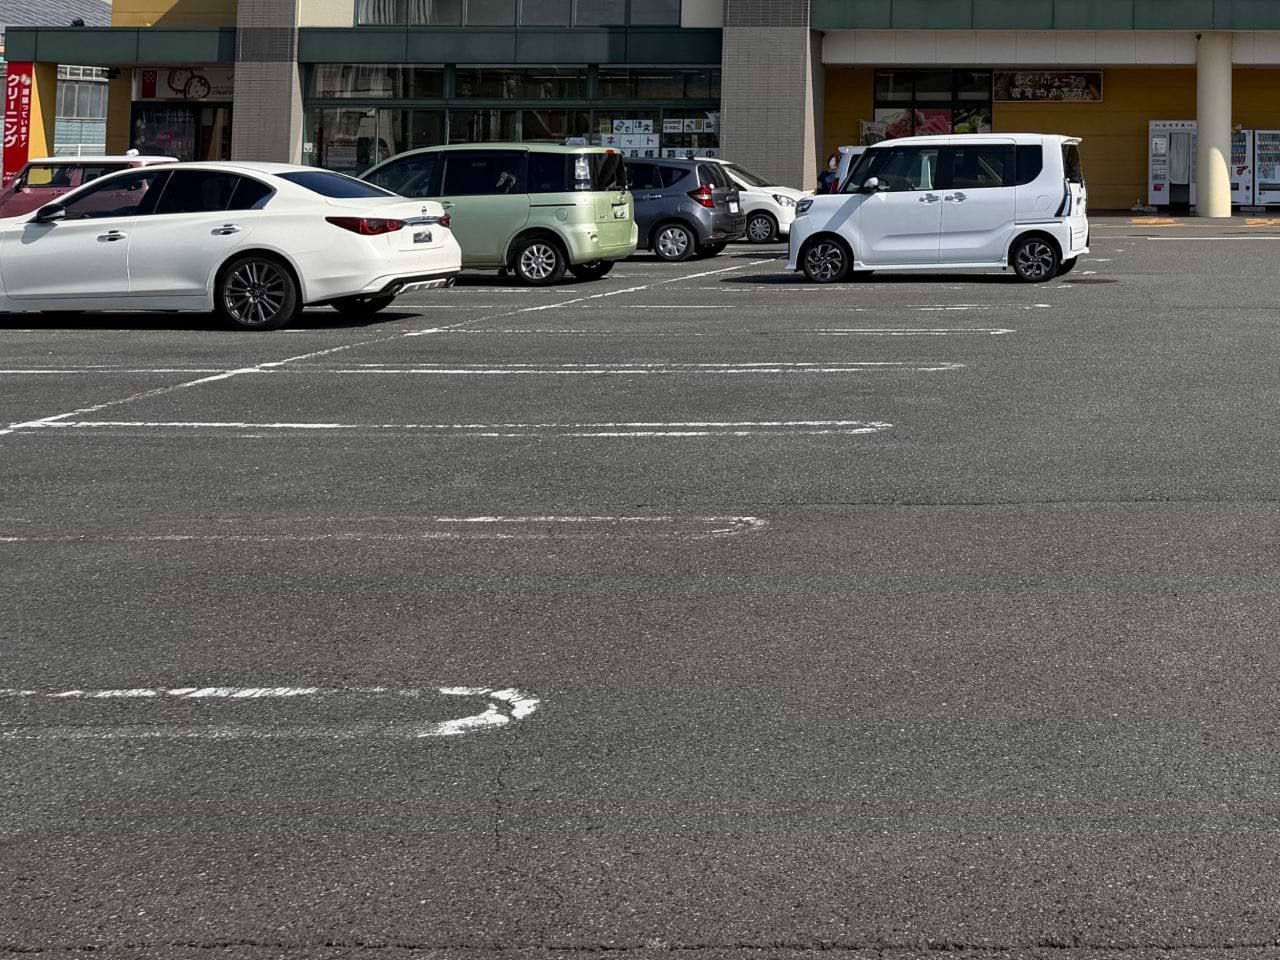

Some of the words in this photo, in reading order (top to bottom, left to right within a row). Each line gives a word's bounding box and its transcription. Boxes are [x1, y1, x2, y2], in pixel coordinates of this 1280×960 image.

[4, 74, 20, 148] クリーニング
